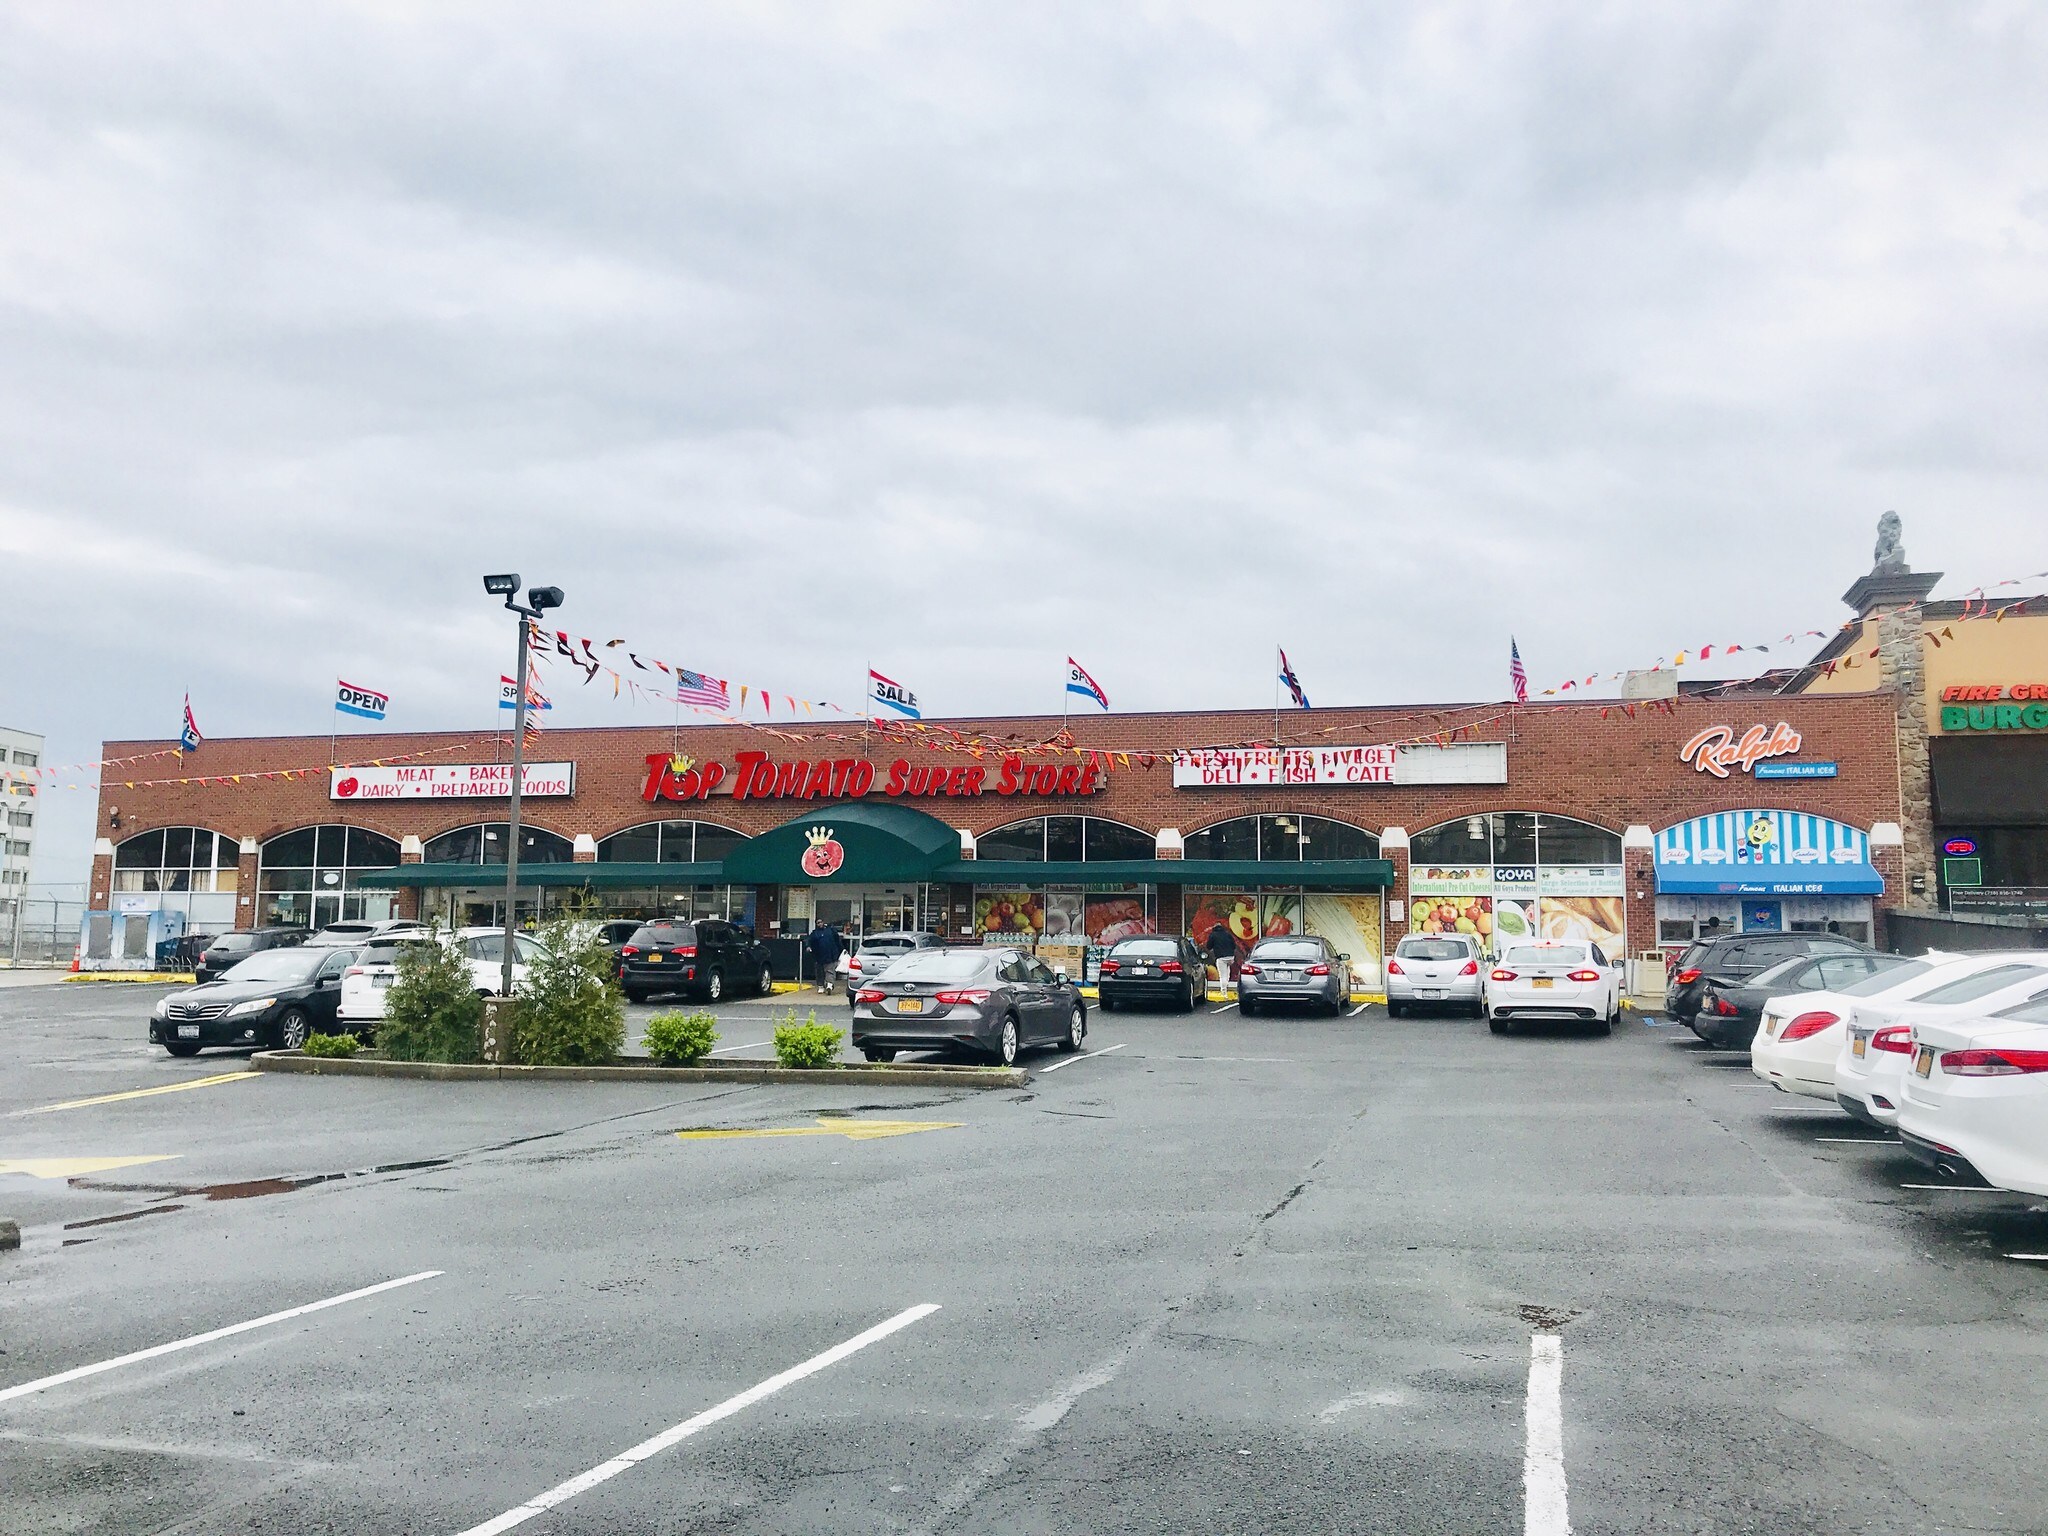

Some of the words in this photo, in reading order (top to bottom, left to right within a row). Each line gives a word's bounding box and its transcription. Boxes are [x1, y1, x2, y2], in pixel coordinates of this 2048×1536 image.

[338, 688, 386, 711] OPEN
[877, 682, 918, 706] SALE
[1942, 685, 2004, 702] FIRE
[2010, 684, 2048, 700] GR
[1942, 703, 2048, 731] BURG
[1681, 722, 1802, 778] Ralph's
[396, 768, 437, 782] MEAT
[733, 751, 875, 800] TOMATO
[885, 758, 987, 797] SUPER
[996, 756, 1100, 796] STORE
[1203, 769, 1241, 784] DELI
[1269, 768, 1316, 783] FISH
[1346, 766, 1394, 782] CATE
[1786, 766, 1815, 774] ITALIAN
[1817, 766, 1835, 774] ICES
[362, 784, 405, 797] DAIRY
[431, 782, 509, 796] PREPARED
[1496, 869, 1535, 881] GOYA
[1412, 881, 1448, 893] International
[1449, 882, 1459, 893] Pre
[1469, 882, 1491, 893] Cheeses
[1515, 884, 1537, 892] Products
[1738, 884, 1767, 892] Famous
[1773, 884, 1803, 892] ITALIAN
[1805, 884, 1823, 892] ICES
